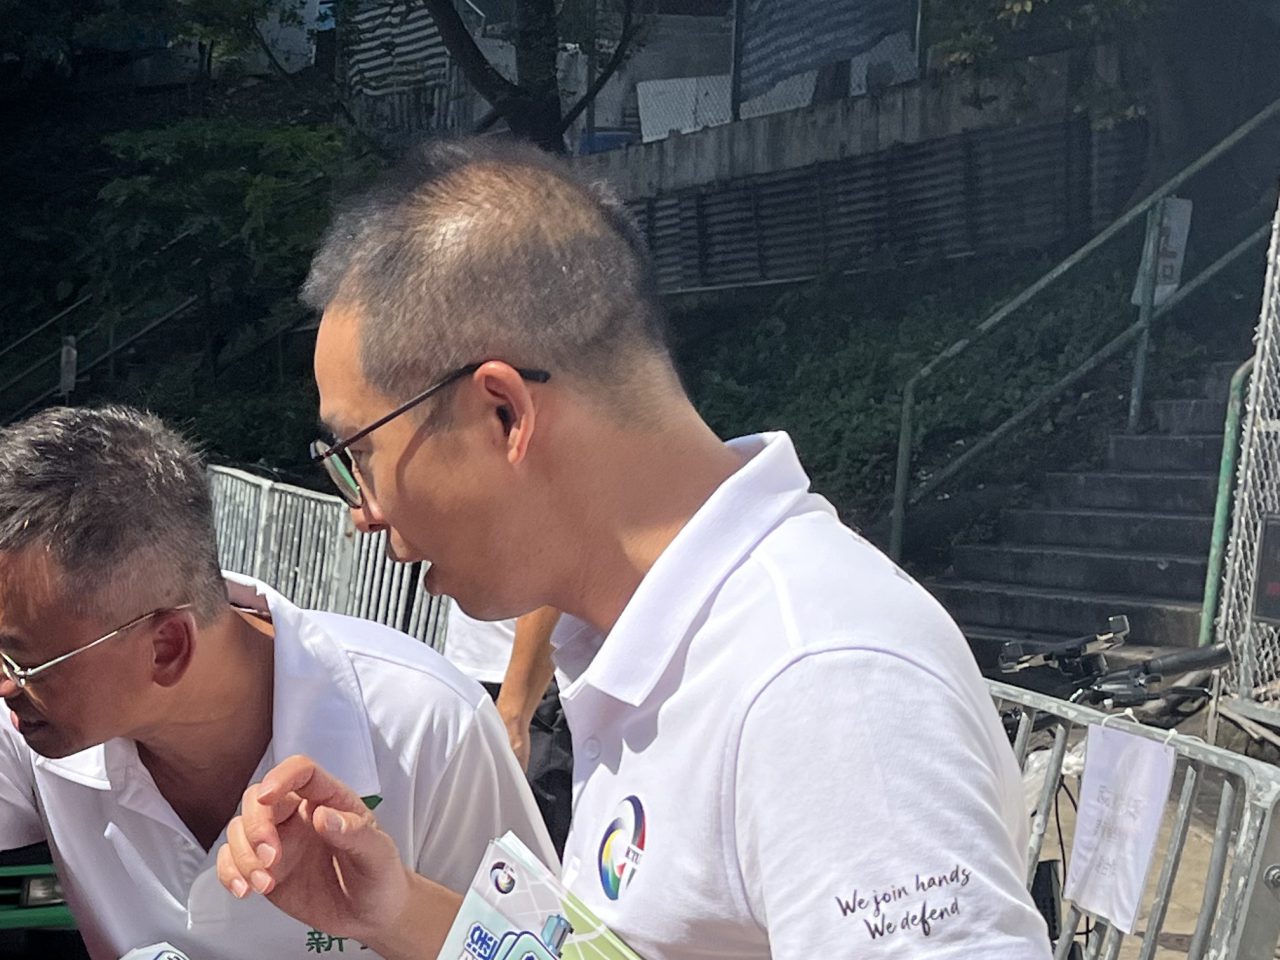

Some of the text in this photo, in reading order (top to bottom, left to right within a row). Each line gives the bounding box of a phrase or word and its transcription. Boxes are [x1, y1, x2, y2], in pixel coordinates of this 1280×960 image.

[834, 864, 972, 918] We join hands
[863, 897, 961, 940] We defend
